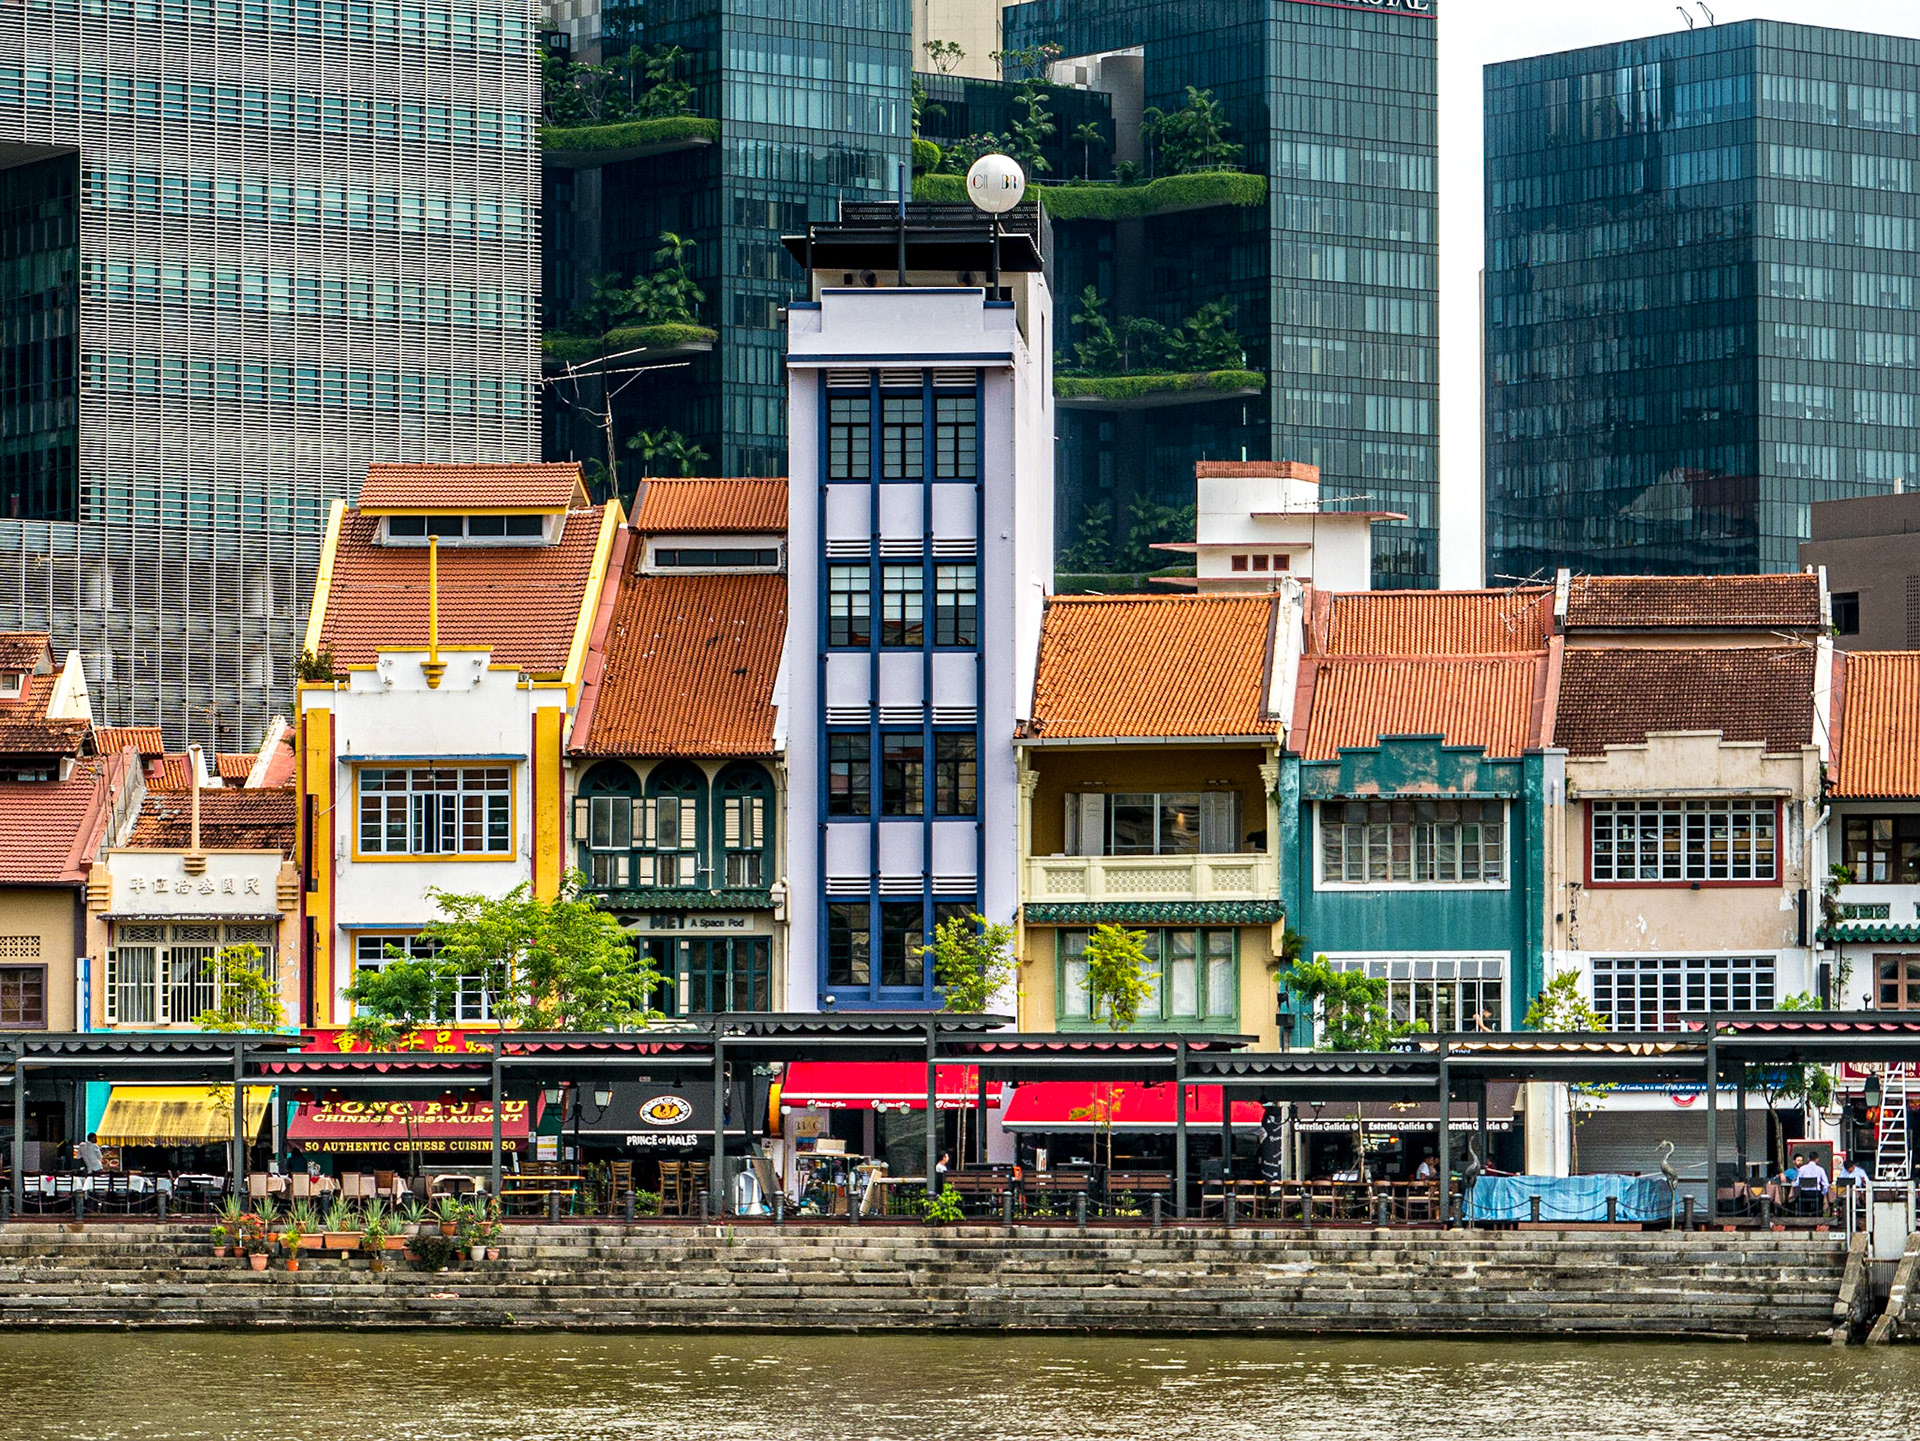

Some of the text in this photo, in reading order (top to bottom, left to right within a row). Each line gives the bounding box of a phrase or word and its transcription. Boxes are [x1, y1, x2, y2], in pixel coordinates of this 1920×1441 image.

[690, 919, 698, 927] A
[700, 919, 724, 929] Space
[728, 918, 744, 927] Pod
[312, 1114, 394, 1123] CHINESE
[1294, 1122, 1350, 1131] Estrella Galicia
[1368, 1122, 1425, 1131] Estrella Galicia
[1448, 1122, 1500, 1131] strella Gicia
[626, 1134, 658, 1146] PRINCE
[666, 1134, 698, 1146] WALES
[304, 1141, 516, 1152] 50 AUTHENTIC CHINESE CUISIN 50
